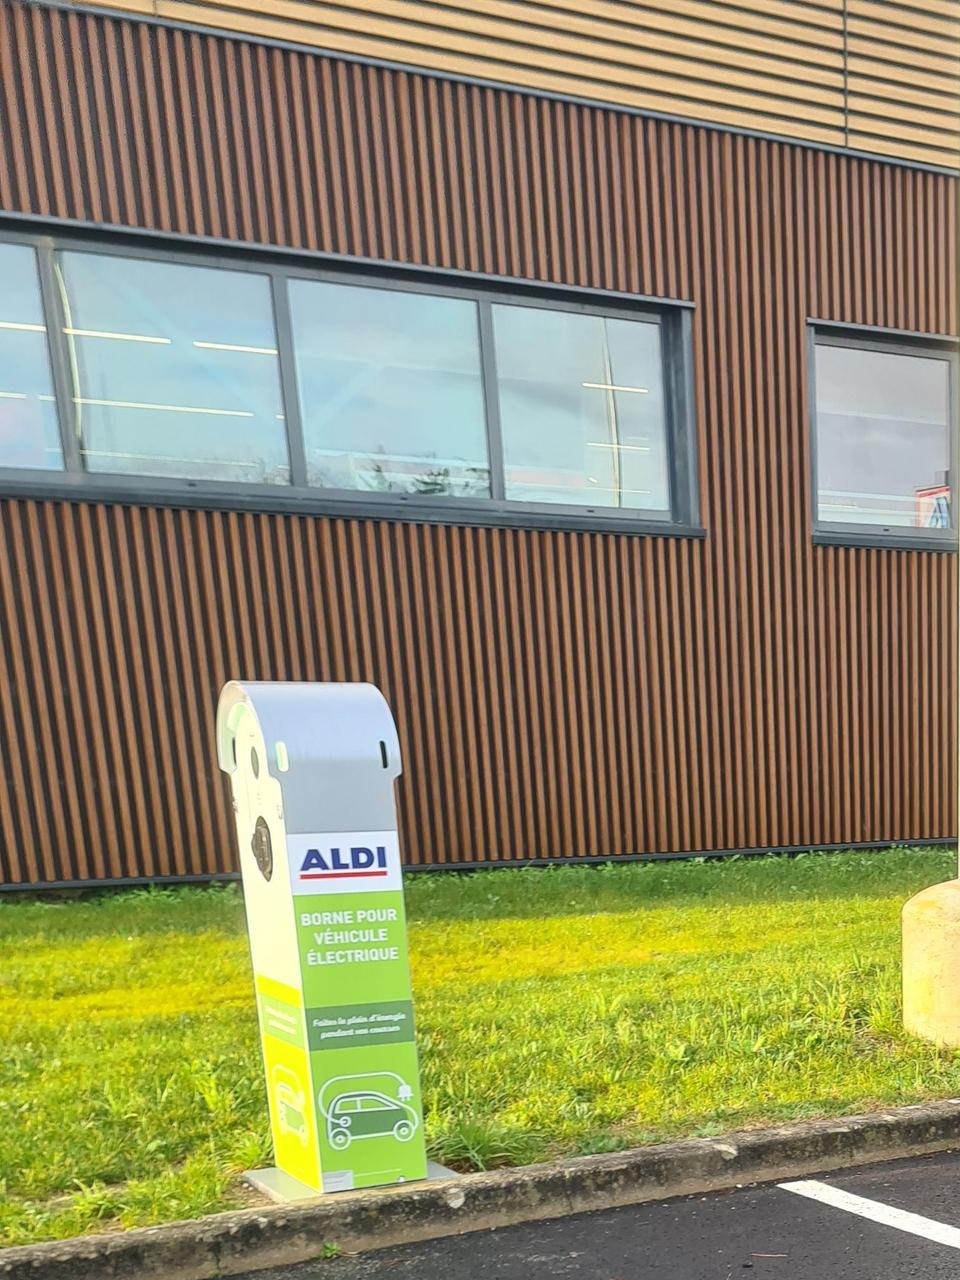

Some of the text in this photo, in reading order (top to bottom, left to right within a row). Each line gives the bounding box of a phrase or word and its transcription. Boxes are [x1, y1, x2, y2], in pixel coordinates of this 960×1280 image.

[300, 846, 388, 871] ALDI
[301, 908, 397, 926] BORNE POUR
[314, 928, 389, 944] VÉHICULE
[307, 947, 399, 966] ÉLECTRIQUE
